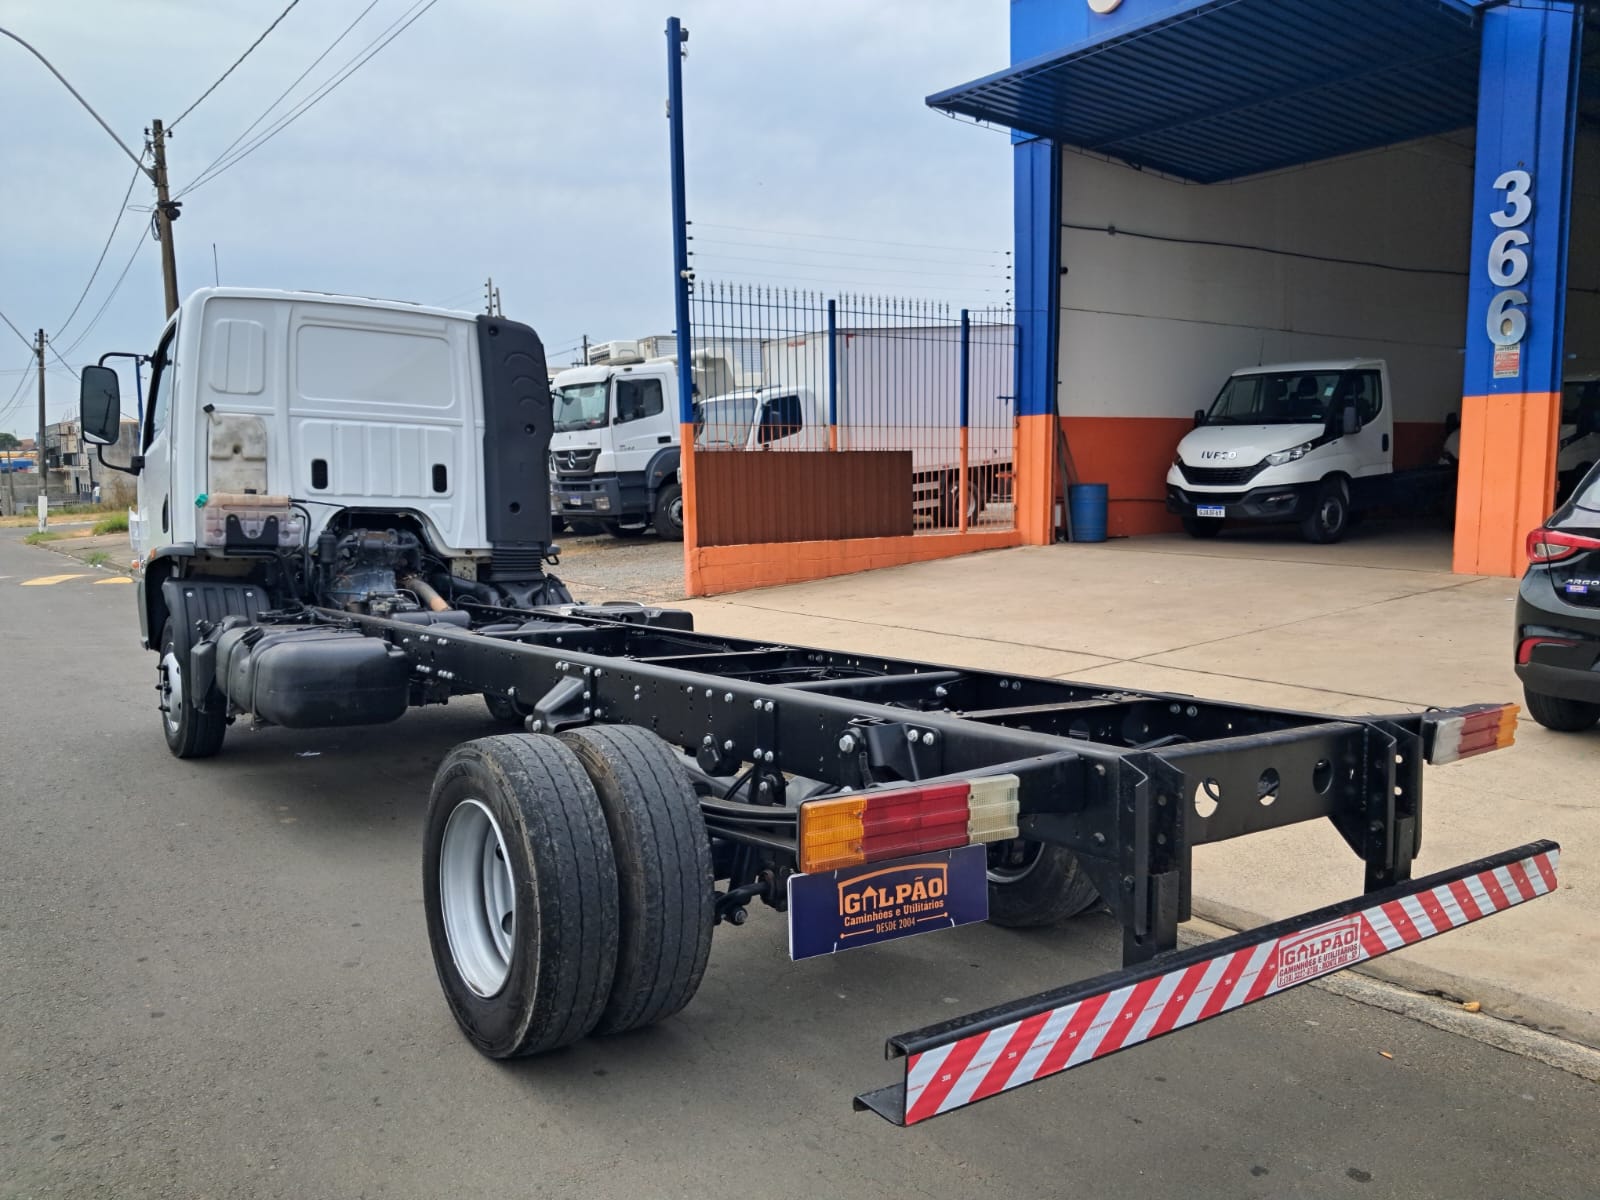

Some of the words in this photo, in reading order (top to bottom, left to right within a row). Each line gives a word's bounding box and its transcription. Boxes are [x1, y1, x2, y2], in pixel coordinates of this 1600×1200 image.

[1486, 169, 1532, 346] 366
[844, 910, 893, 928] Caminhões
[895, 908, 901, 917] e
[903, 898, 945, 915] Utilitários
[875, 920, 897, 934] DESDE
[899, 916, 917, 930] 2004
[1279, 958, 1317, 978] CAMINHÕES
